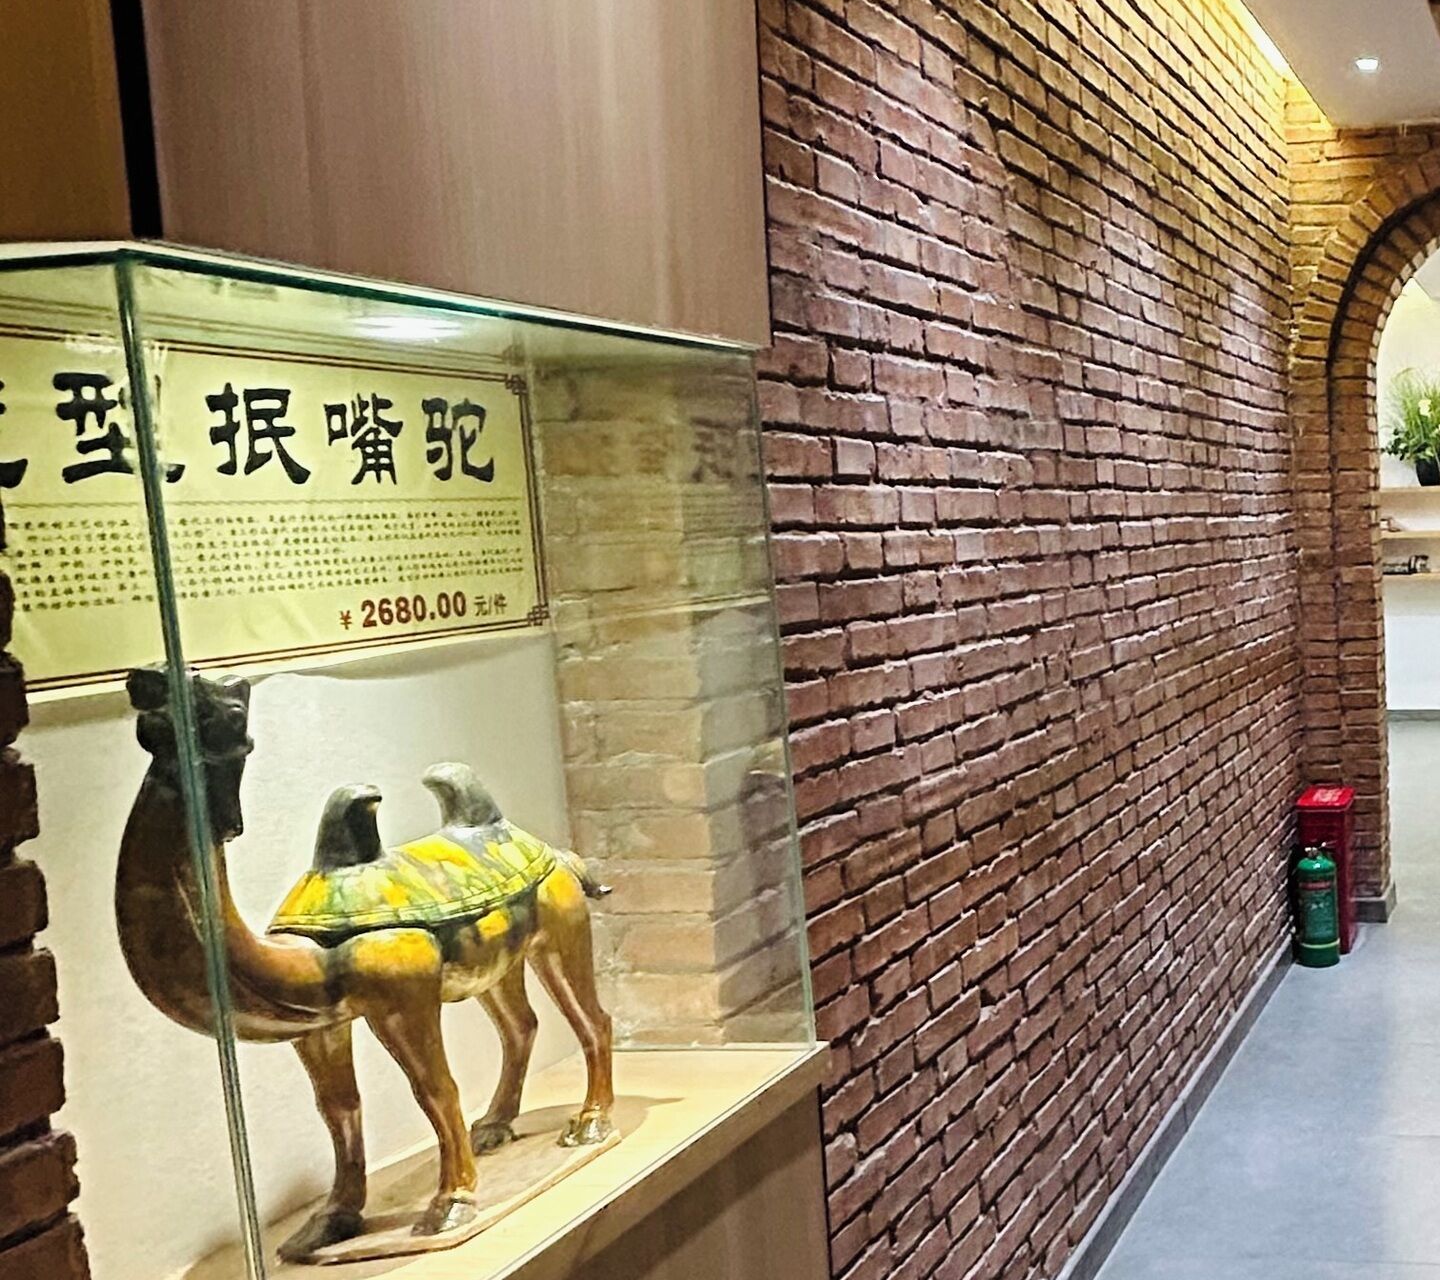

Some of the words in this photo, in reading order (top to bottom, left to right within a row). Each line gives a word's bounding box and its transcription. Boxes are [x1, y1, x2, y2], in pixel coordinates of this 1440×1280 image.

[0, 372, 495, 488] 型抿嘴驼
[361, 590, 467, 628] 2680.00
